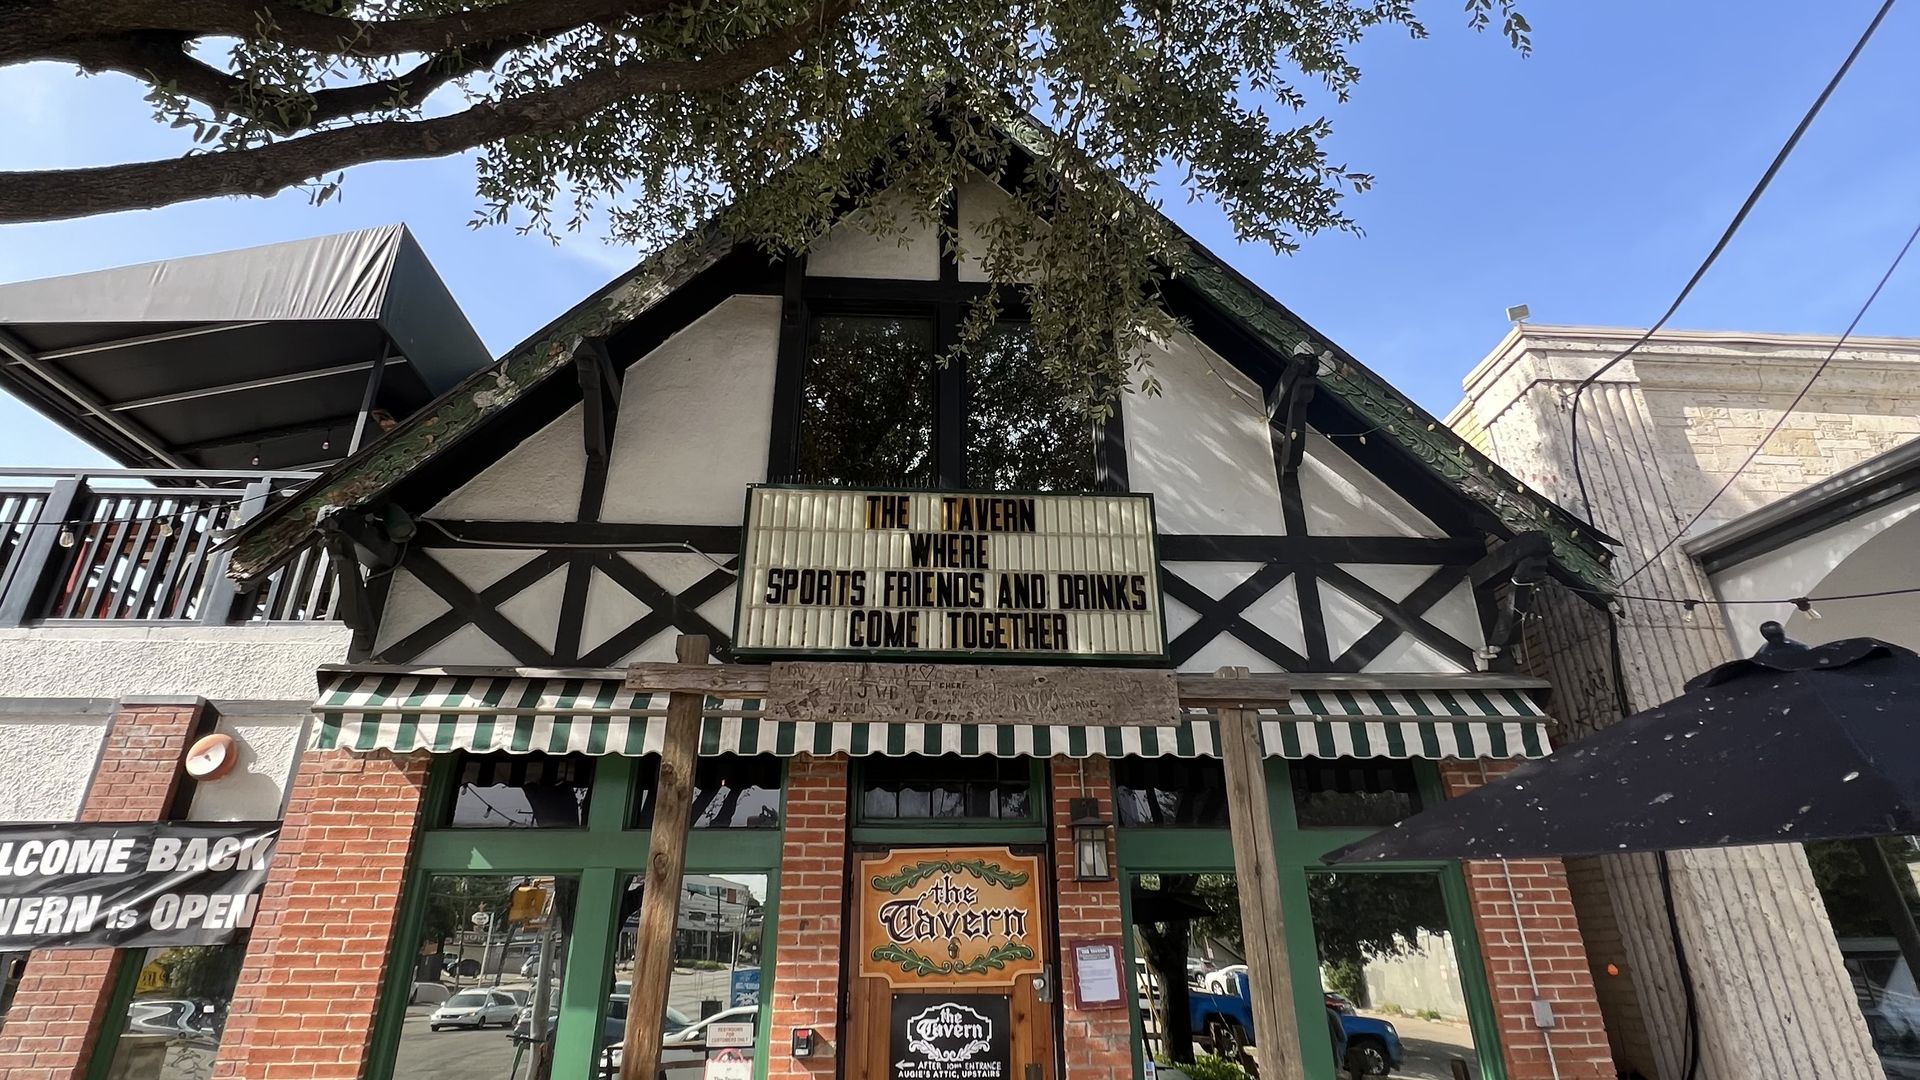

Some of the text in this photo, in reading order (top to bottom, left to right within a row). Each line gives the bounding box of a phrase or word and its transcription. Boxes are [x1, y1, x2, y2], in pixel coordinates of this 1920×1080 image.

[866, 495, 1035, 533] THE TAVERN
[909, 533, 988, 568] WHERE
[766, 568, 1147, 611] SPORTS FRIENDS AND DRINKS
[849, 610, 1068, 650] COME TOGETHER
[146, 837, 273, 873] BACK
[930, 874, 978, 905] the
[149, 893, 260, 931] OPEN
[879, 892, 1028, 943] Tavern
[916, 1017, 983, 1041] Tavern
[940, 1007, 963, 1024] the
[897, 1070, 1001, 1079] AUGIE'S ATTIC, UPSTAIRS
[918, 1061, 942, 1071] AFTER
[964, 1061, 1002, 1071] ENTRANCE
